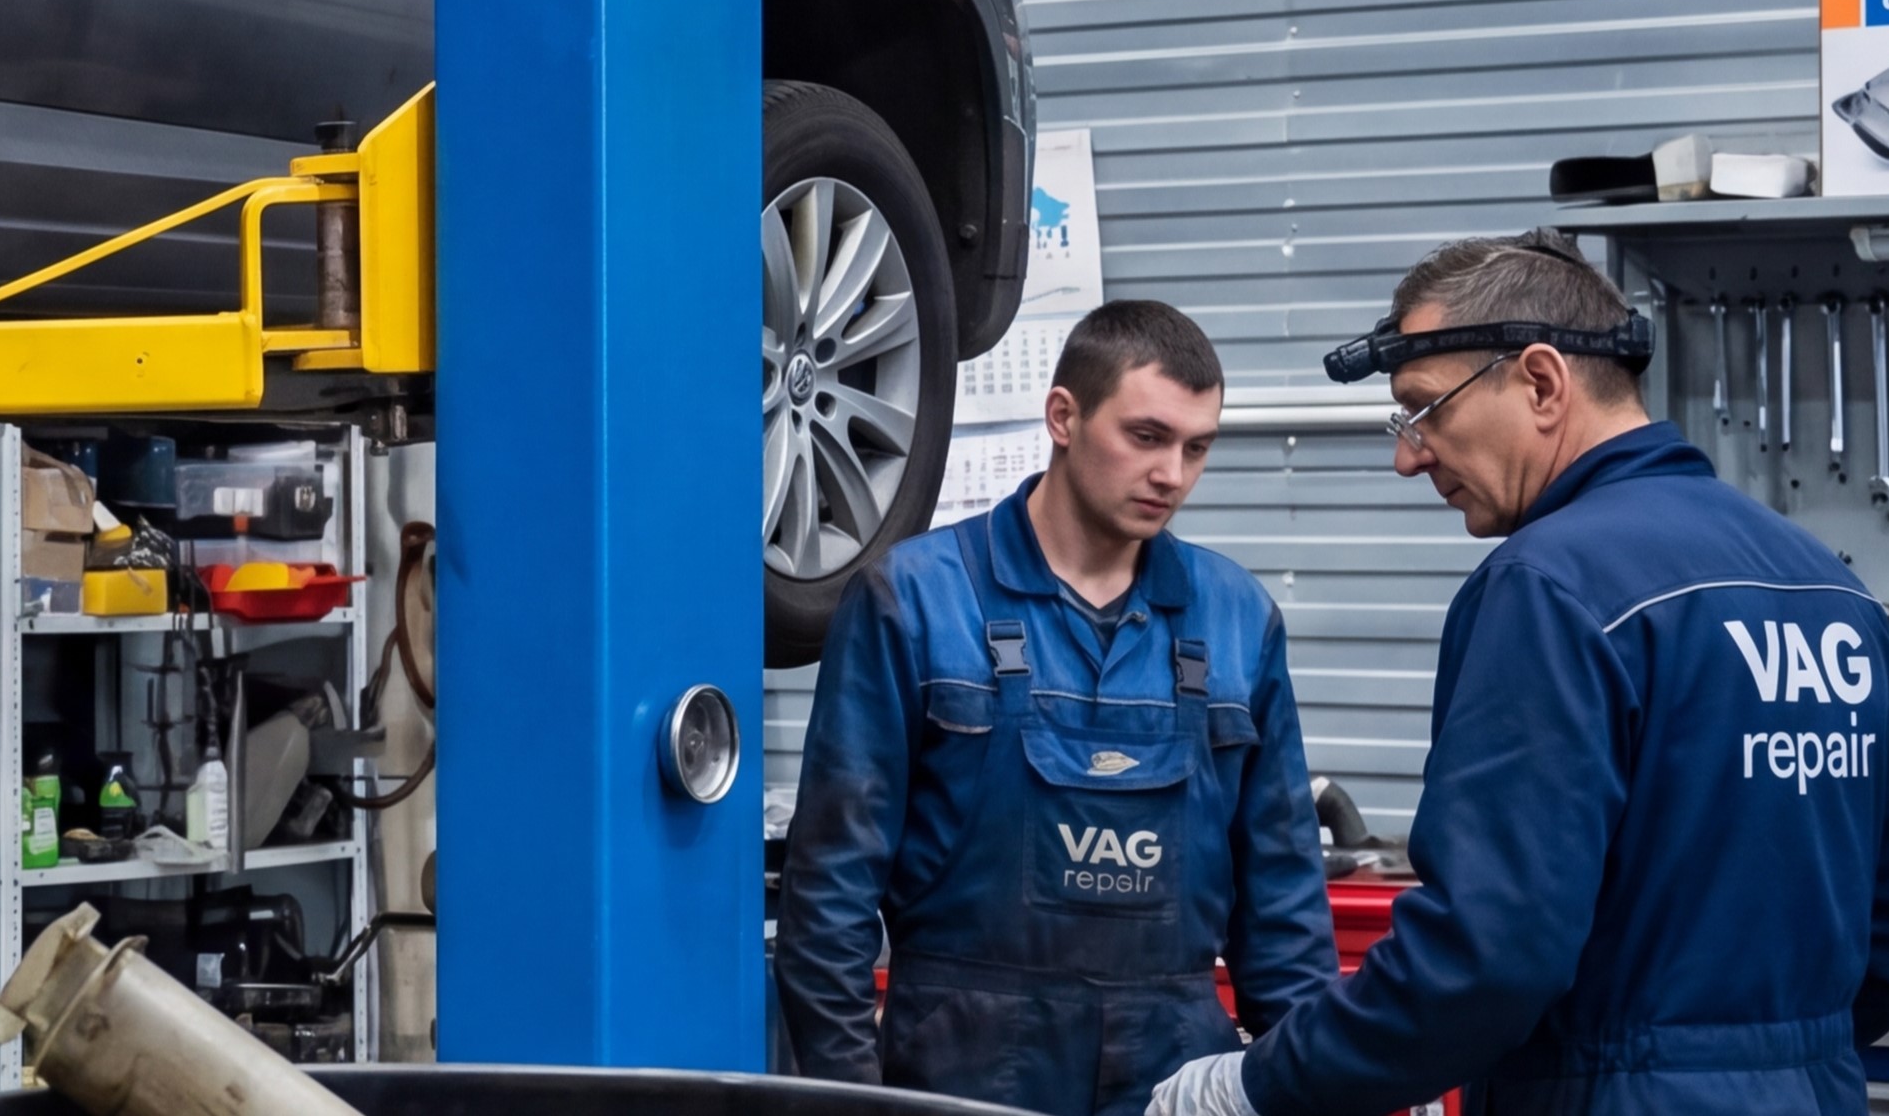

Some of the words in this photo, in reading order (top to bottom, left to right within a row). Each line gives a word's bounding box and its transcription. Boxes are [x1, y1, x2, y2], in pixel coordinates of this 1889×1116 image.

[1722, 620, 1873, 705] VAG
[1743, 711, 1877, 795] repair
[1057, 823, 1163, 869] VAG
